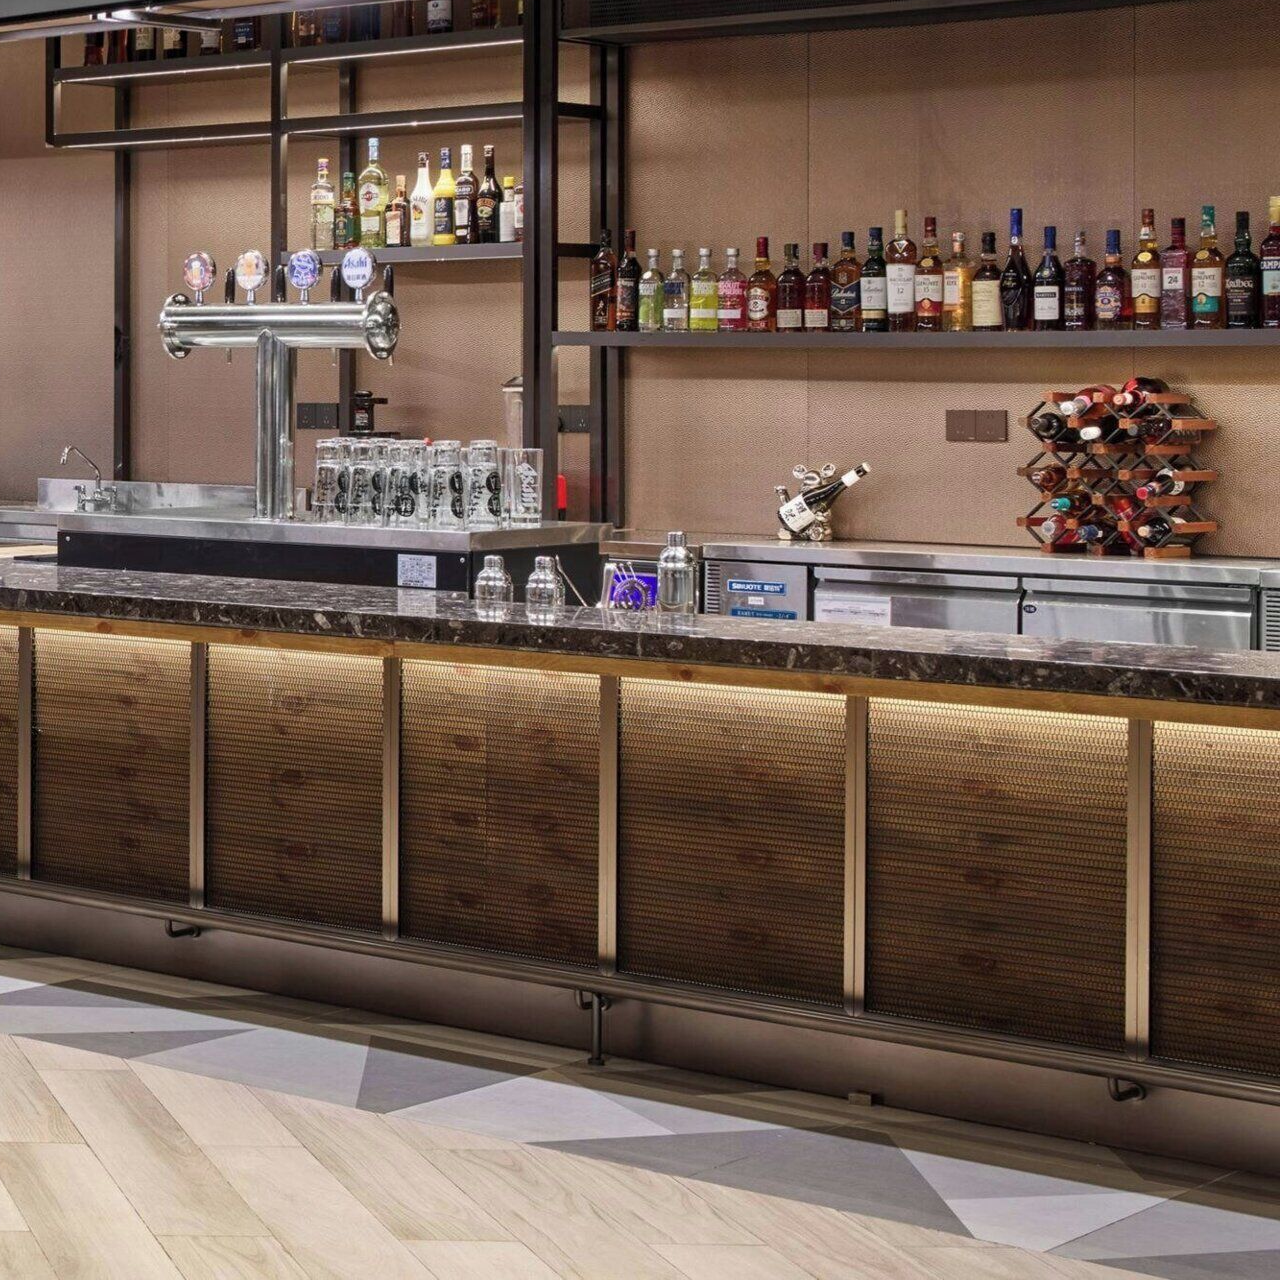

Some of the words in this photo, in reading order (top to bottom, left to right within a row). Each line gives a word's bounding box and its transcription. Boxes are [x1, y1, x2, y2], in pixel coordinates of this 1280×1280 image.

[345, 259, 368, 270] Asahi
[1167, 275, 1179, 285] 24
[897, 286, 905, 294] 12
